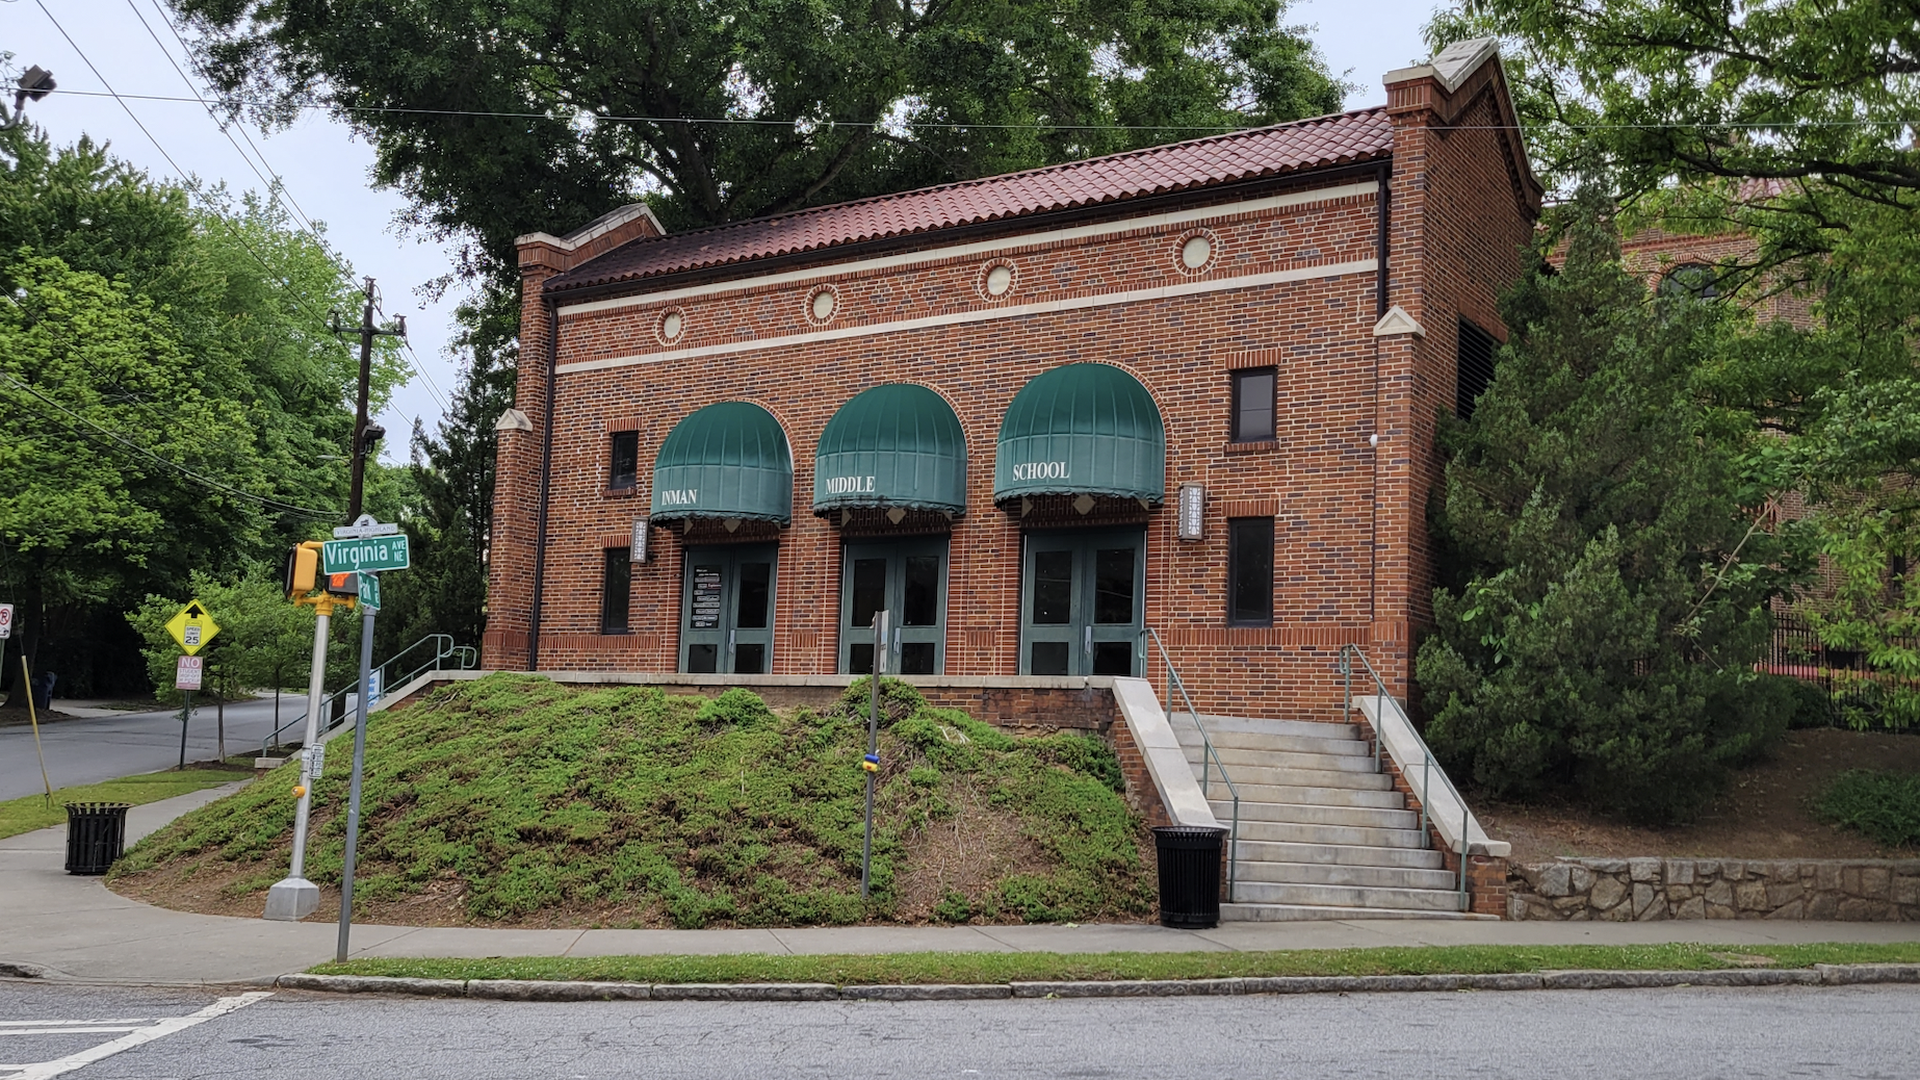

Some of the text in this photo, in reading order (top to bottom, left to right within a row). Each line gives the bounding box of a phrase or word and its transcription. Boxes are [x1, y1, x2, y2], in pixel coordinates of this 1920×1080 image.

[1013, 461, 1070, 482] SCHOOL
[825, 475, 876, 495] MIDDLE
[661, 489, 698, 506] INMAN
[326, 540, 406, 569] Virginia AVE
[394, 551, 404, 562] NE
[185, 636, 199, 645] 25
[181, 657, 200, 668] NO
